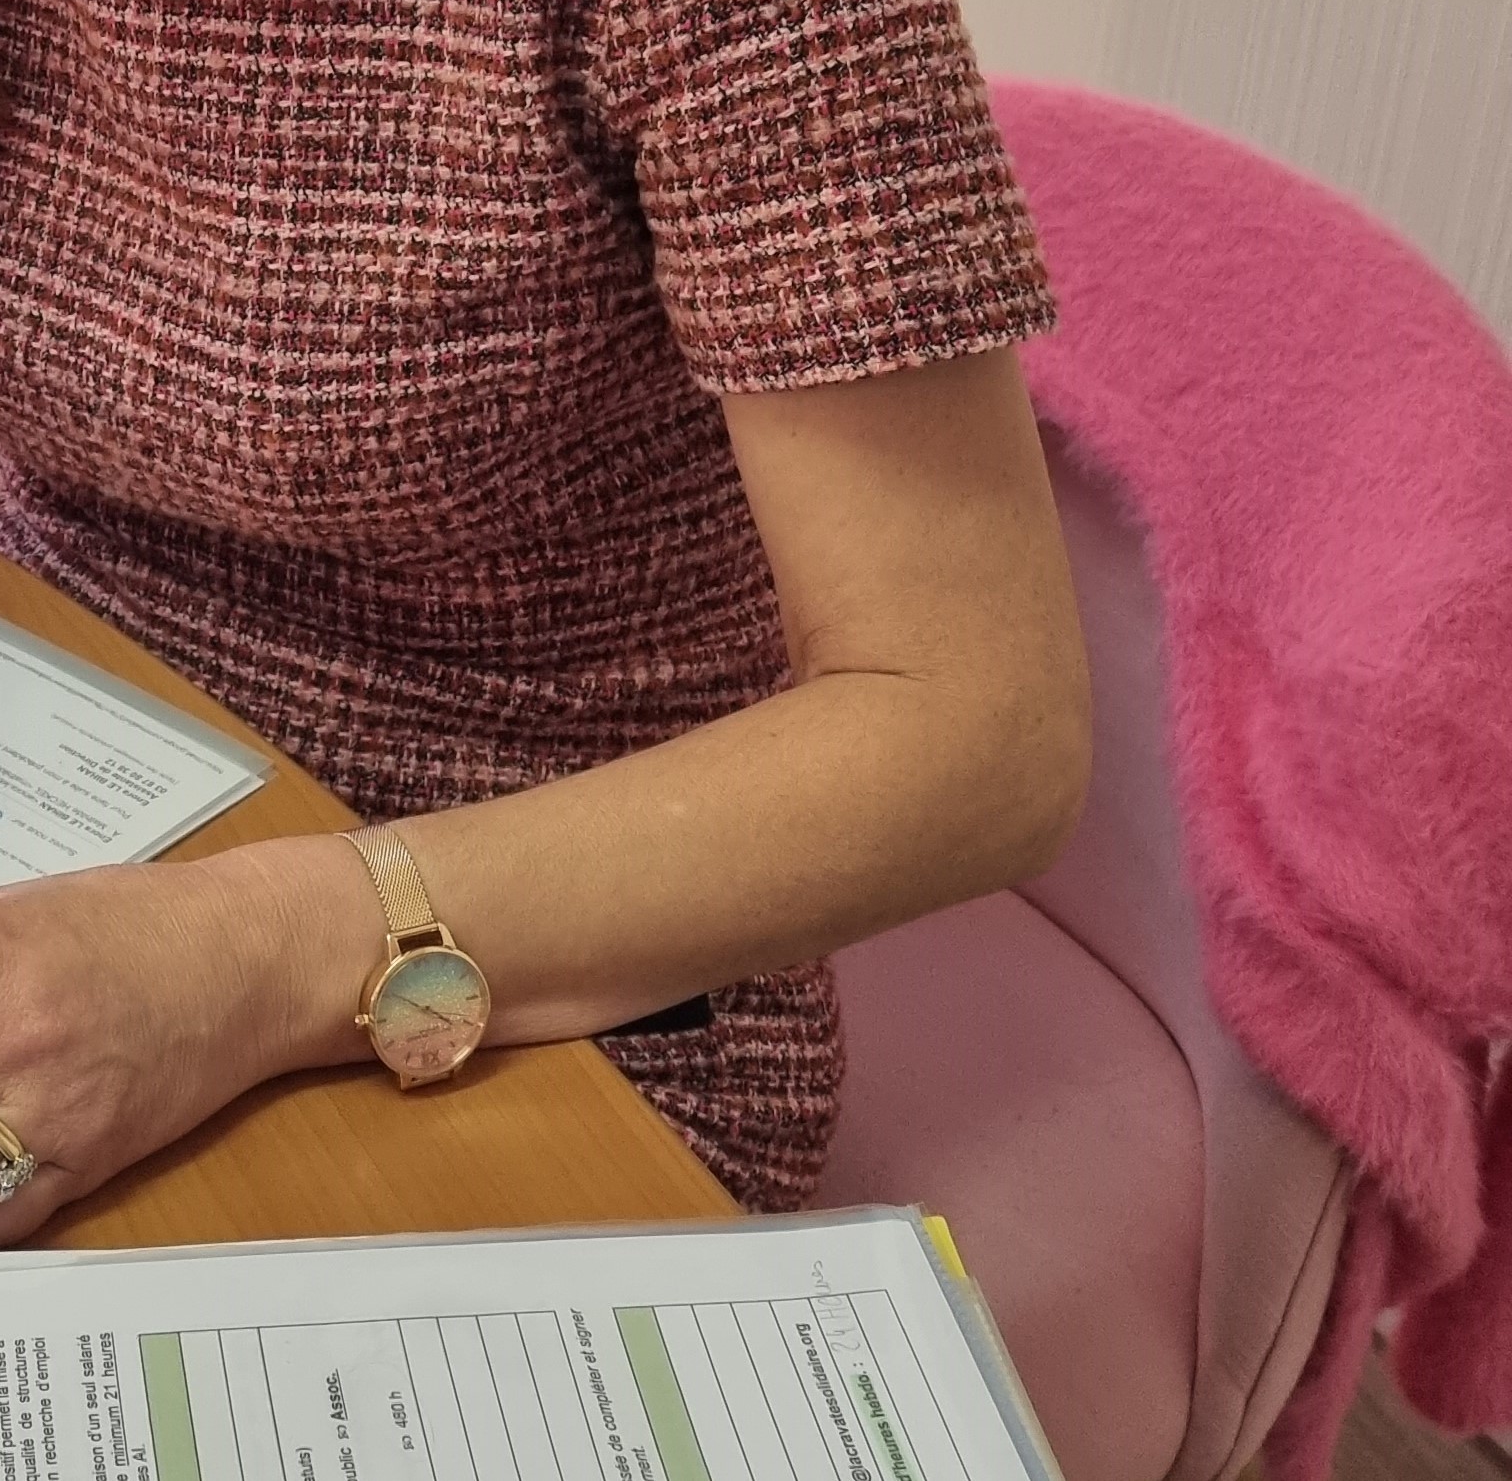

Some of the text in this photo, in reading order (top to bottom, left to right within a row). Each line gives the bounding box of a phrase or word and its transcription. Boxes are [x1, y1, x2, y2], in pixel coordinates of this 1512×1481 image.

[567, 1303, 597, 1350] signer
[75, 1333, 95, 1378] salarié
[578, 1347, 598, 1365] et
[10, 1338, 41, 1481] qualité de structures
[30, 1335, 58, 1465] recherche d'emploi
[80, 1380, 98, 1409] seul
[96, 1331, 129, 1467] minimum 21 heures
[321, 1367, 349, 1423] Assoc.
[387, 1388, 410, 1430] 480 h
[582, 1360, 622, 1434] compléter
[84, 1412, 102, 1442] d'un
[603, 1431, 624, 1454] de
